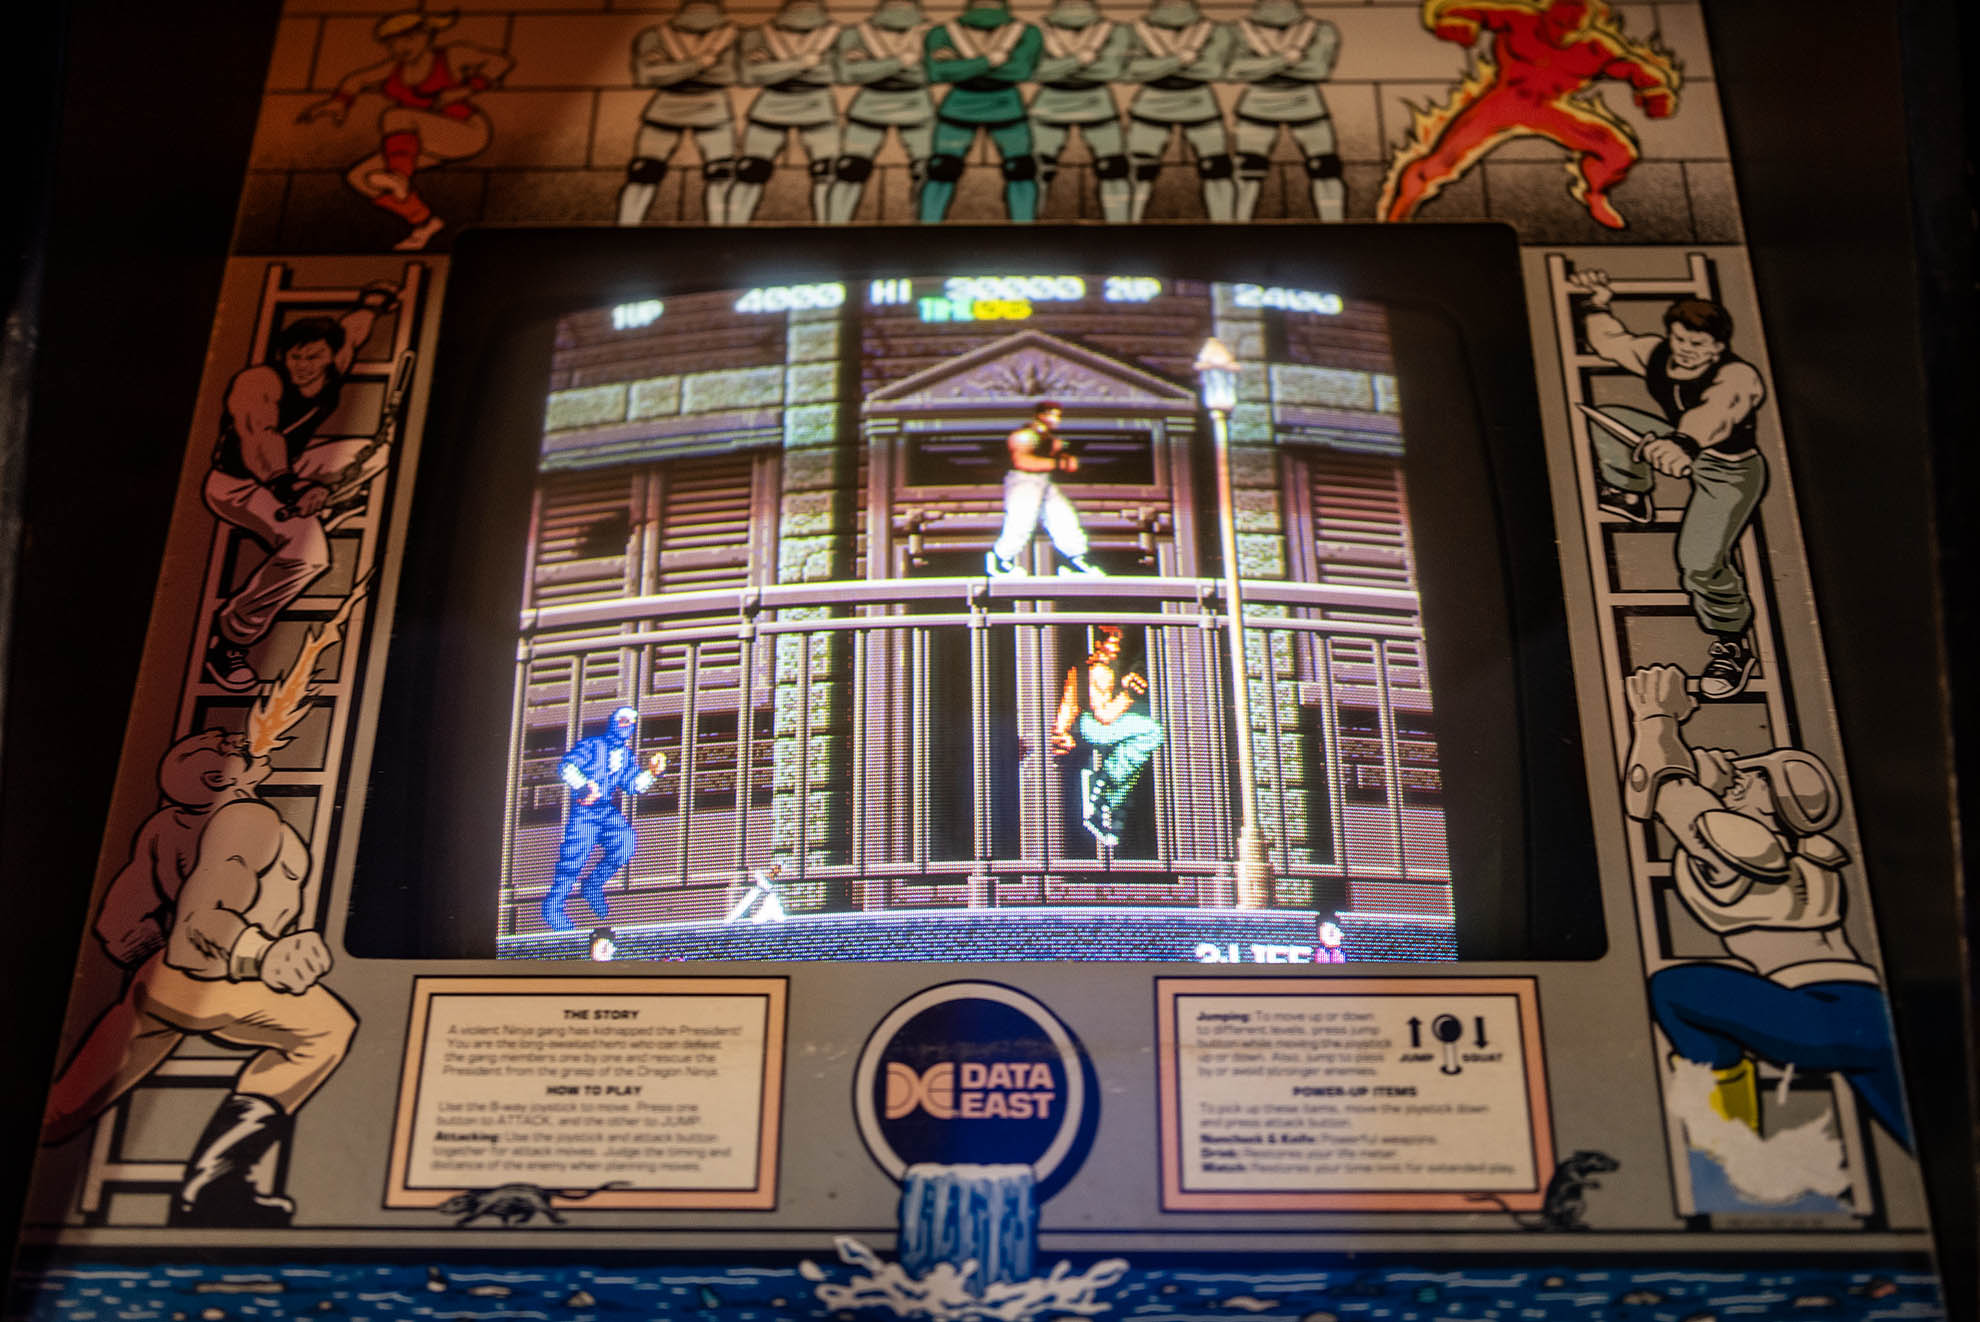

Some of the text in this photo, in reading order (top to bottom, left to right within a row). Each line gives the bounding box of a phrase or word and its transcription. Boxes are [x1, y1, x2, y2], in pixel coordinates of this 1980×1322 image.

[733, 281, 847, 313] 4000
[869, 278, 913, 305] HI
[563, 1009, 640, 1021] THE STORY
[960, 1062, 1055, 1090] DATA
[546, 1085, 643, 1096] HOW TO PLAY
[1292, 1085, 1419, 1097] POWER-UP ITEMS
[960, 1091, 1056, 1119] EAST
